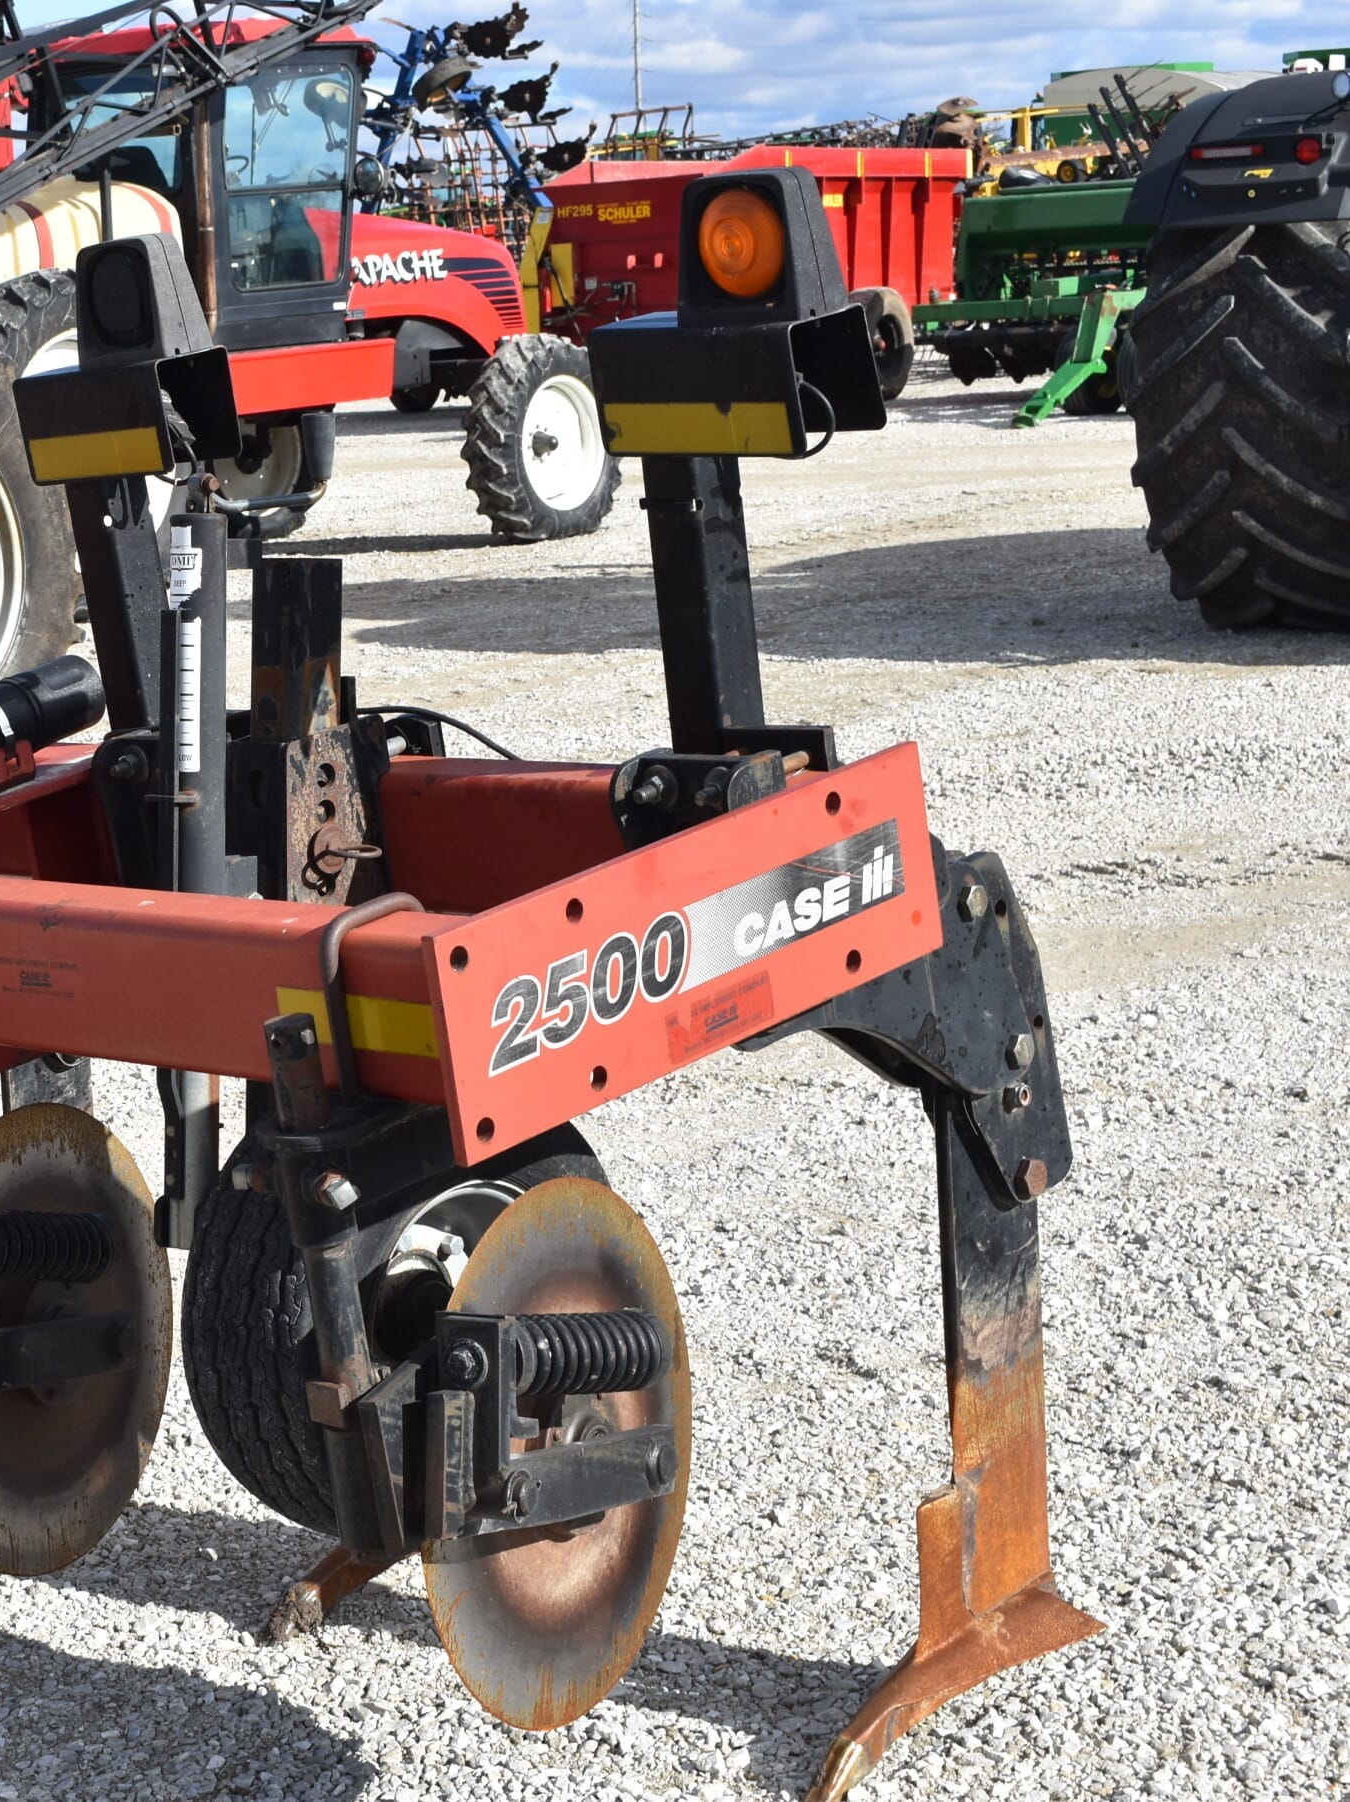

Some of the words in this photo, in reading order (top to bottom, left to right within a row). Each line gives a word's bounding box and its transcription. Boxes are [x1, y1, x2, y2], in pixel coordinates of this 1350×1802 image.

[557, 205, 594, 219] HF295
[597, 205, 651, 222] SCHULER
[350, 248, 448, 285] APACHE
[178, 753, 193, 762] LOW
[488, 910, 689, 1078] 2500
[733, 874, 851, 958] CASE
[705, 1008, 728, 1028] CASE
